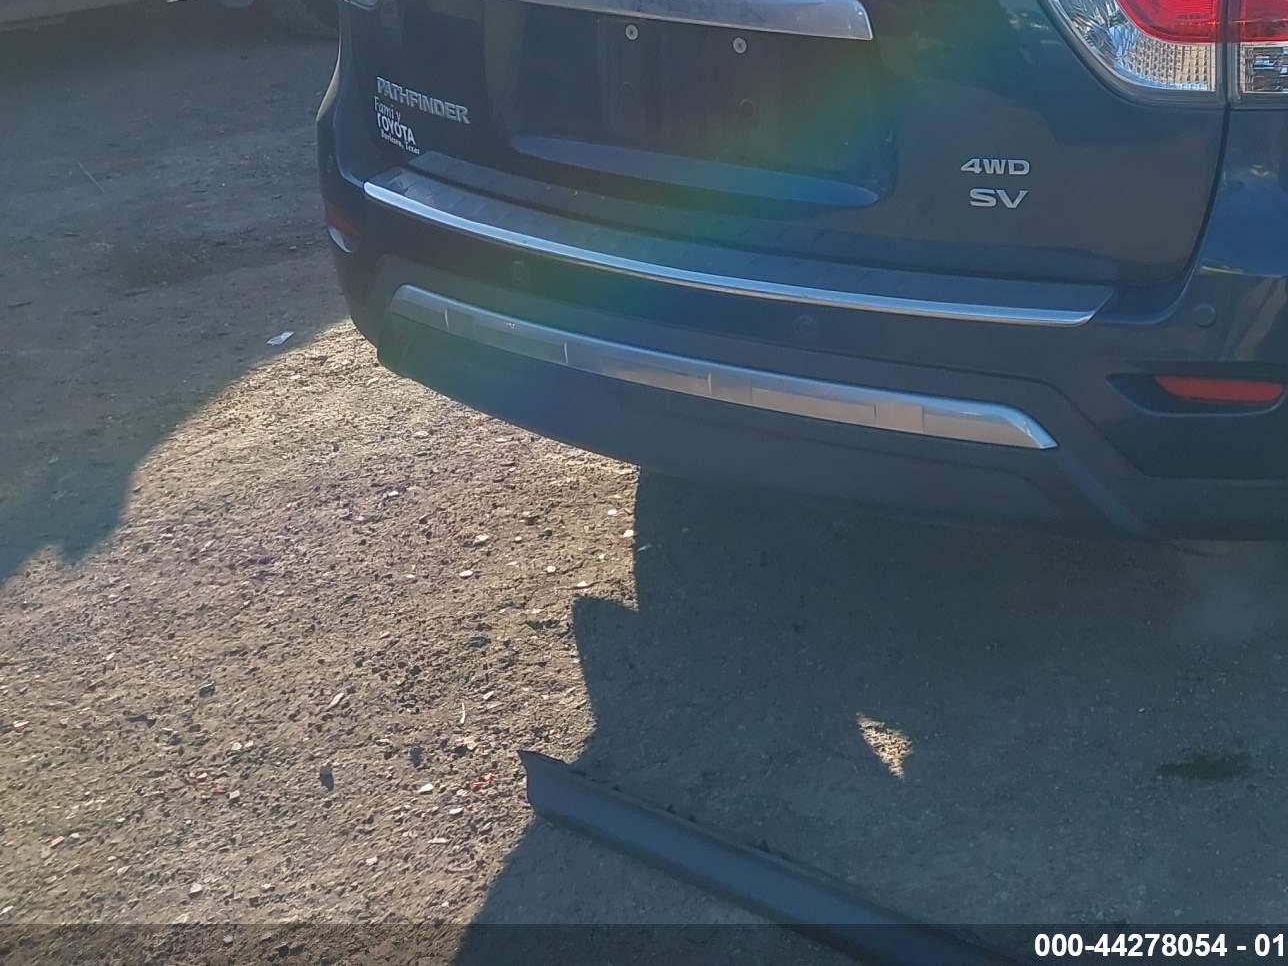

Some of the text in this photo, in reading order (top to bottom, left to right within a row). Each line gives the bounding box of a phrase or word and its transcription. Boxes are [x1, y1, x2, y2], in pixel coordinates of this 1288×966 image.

[377, 76, 471, 124] PATHFINDER
[377, 113, 417, 145] TOYOTA
[960, 158, 1030, 175] 4WD
[969, 188, 1029, 209] SV
